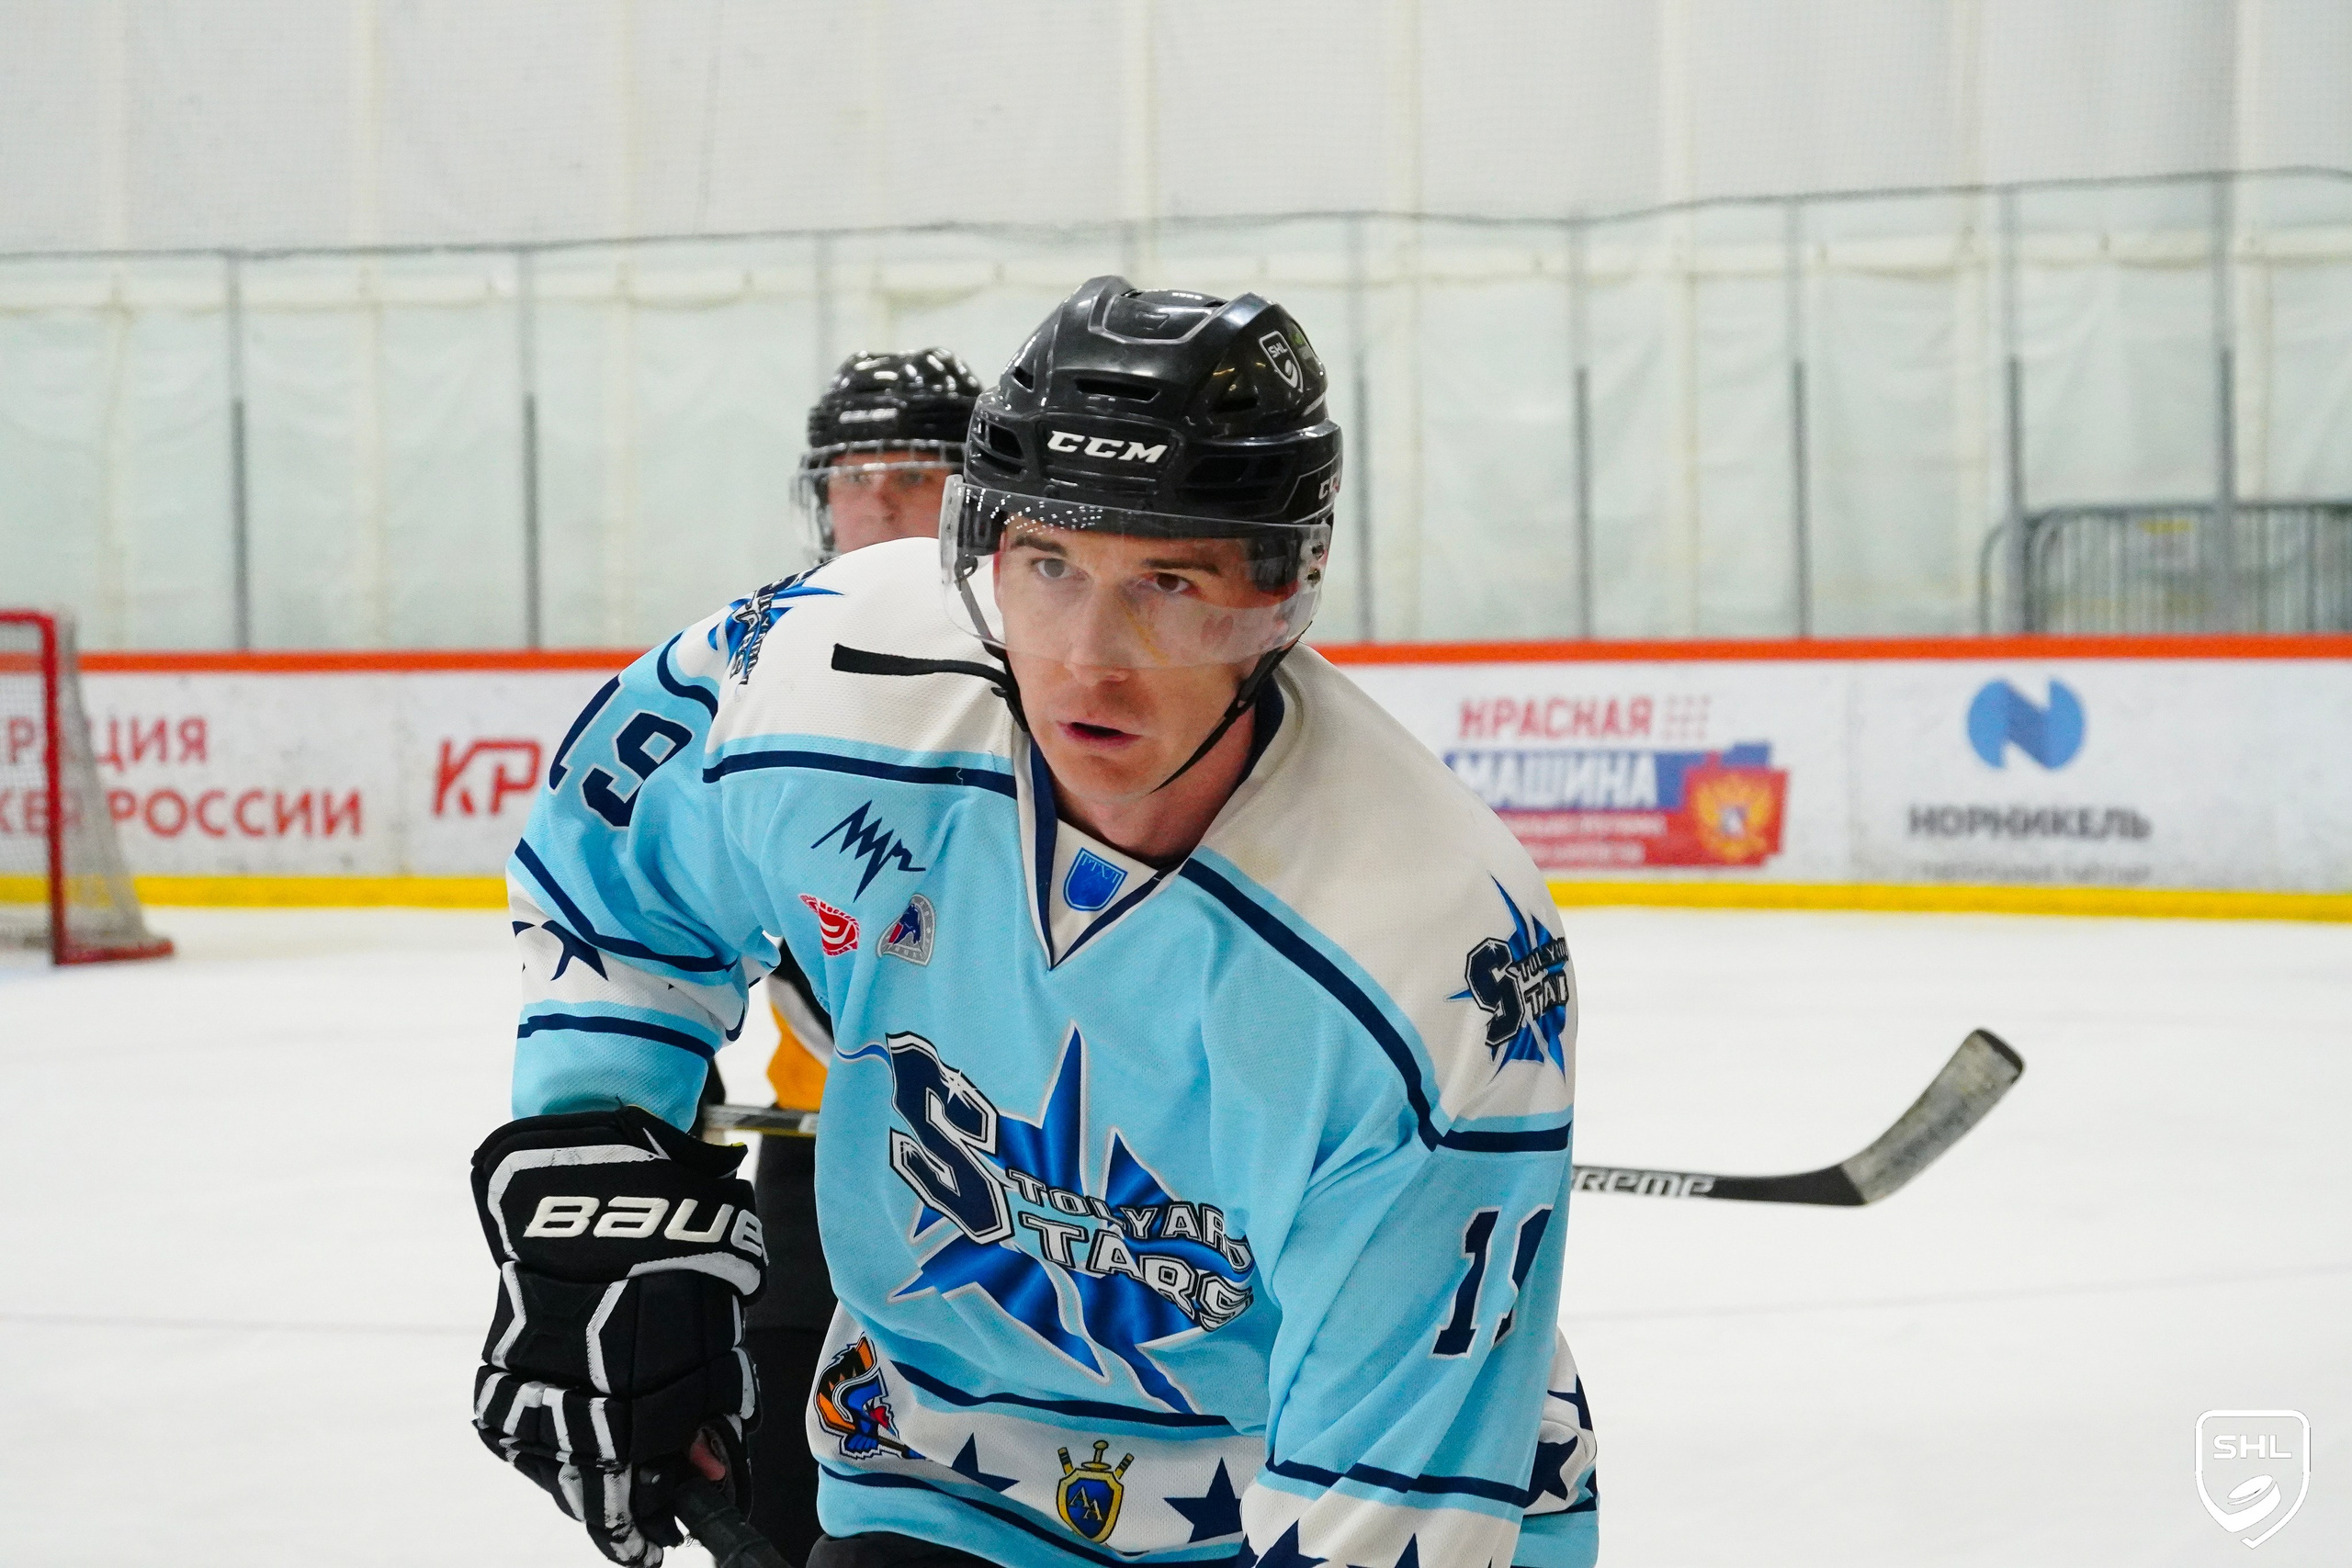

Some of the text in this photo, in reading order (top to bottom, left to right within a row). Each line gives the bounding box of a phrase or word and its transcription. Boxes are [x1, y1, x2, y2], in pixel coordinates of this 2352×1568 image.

[1046, 430, 1169, 464] CCM
[1460, 695, 1653, 741] КРАСНАЯ
[1450, 751, 1657, 810] МАШИНА
[105, 787, 363, 840] РОССИИ
[1908, 803, 2151, 841] НОРНИКЕЛЬ
[523, 1195, 766, 1259] BAUE
[1017, 1210, 1254, 1332] TARS
